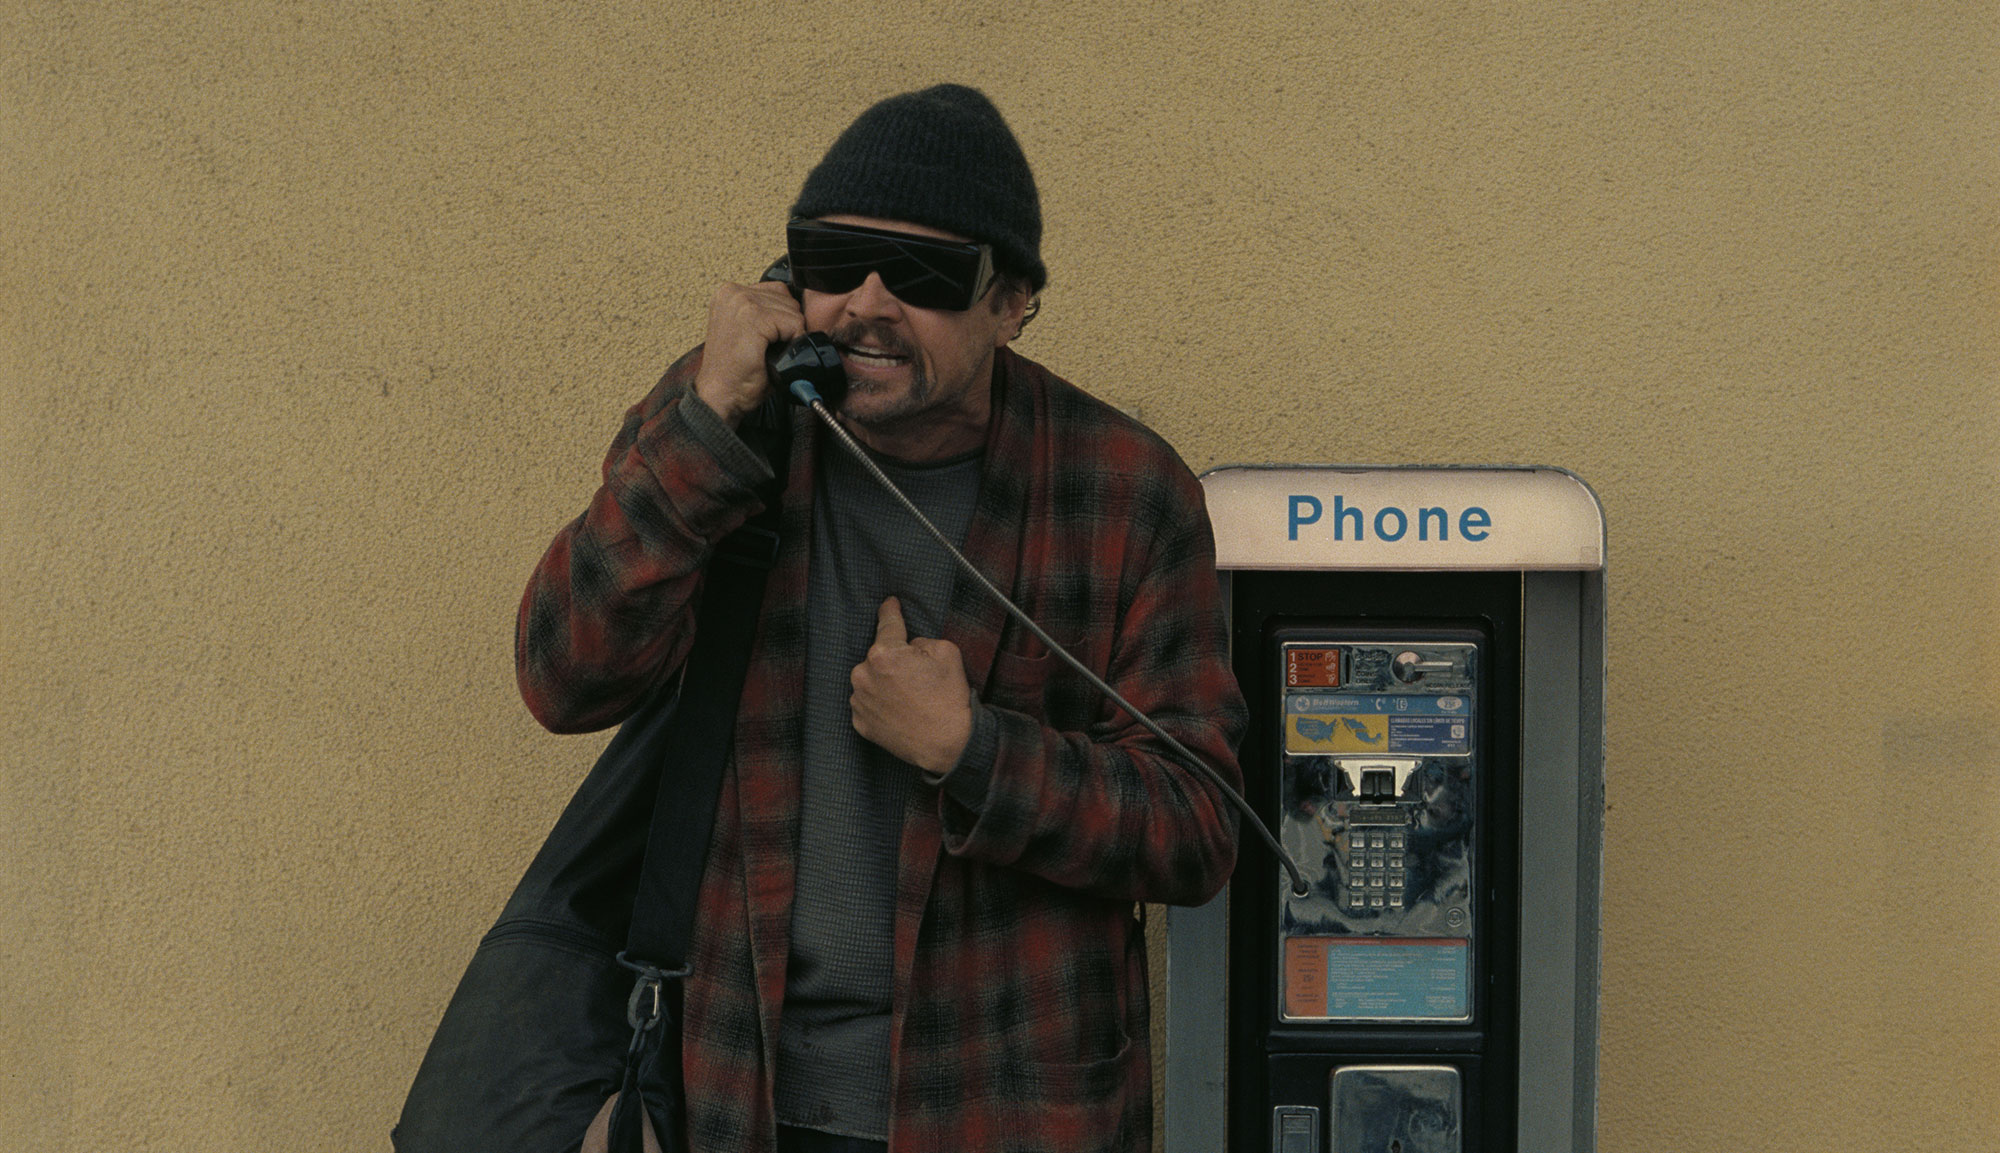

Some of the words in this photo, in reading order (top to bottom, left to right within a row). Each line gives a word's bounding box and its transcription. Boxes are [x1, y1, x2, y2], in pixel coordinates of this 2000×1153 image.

[1288, 495, 1492, 542] Phone
[1290, 651, 1296, 662] 1
[1298, 653, 1323, 661] STOP
[1289, 663, 1297, 673] 2
[1289, 674, 1297, 685] 3
